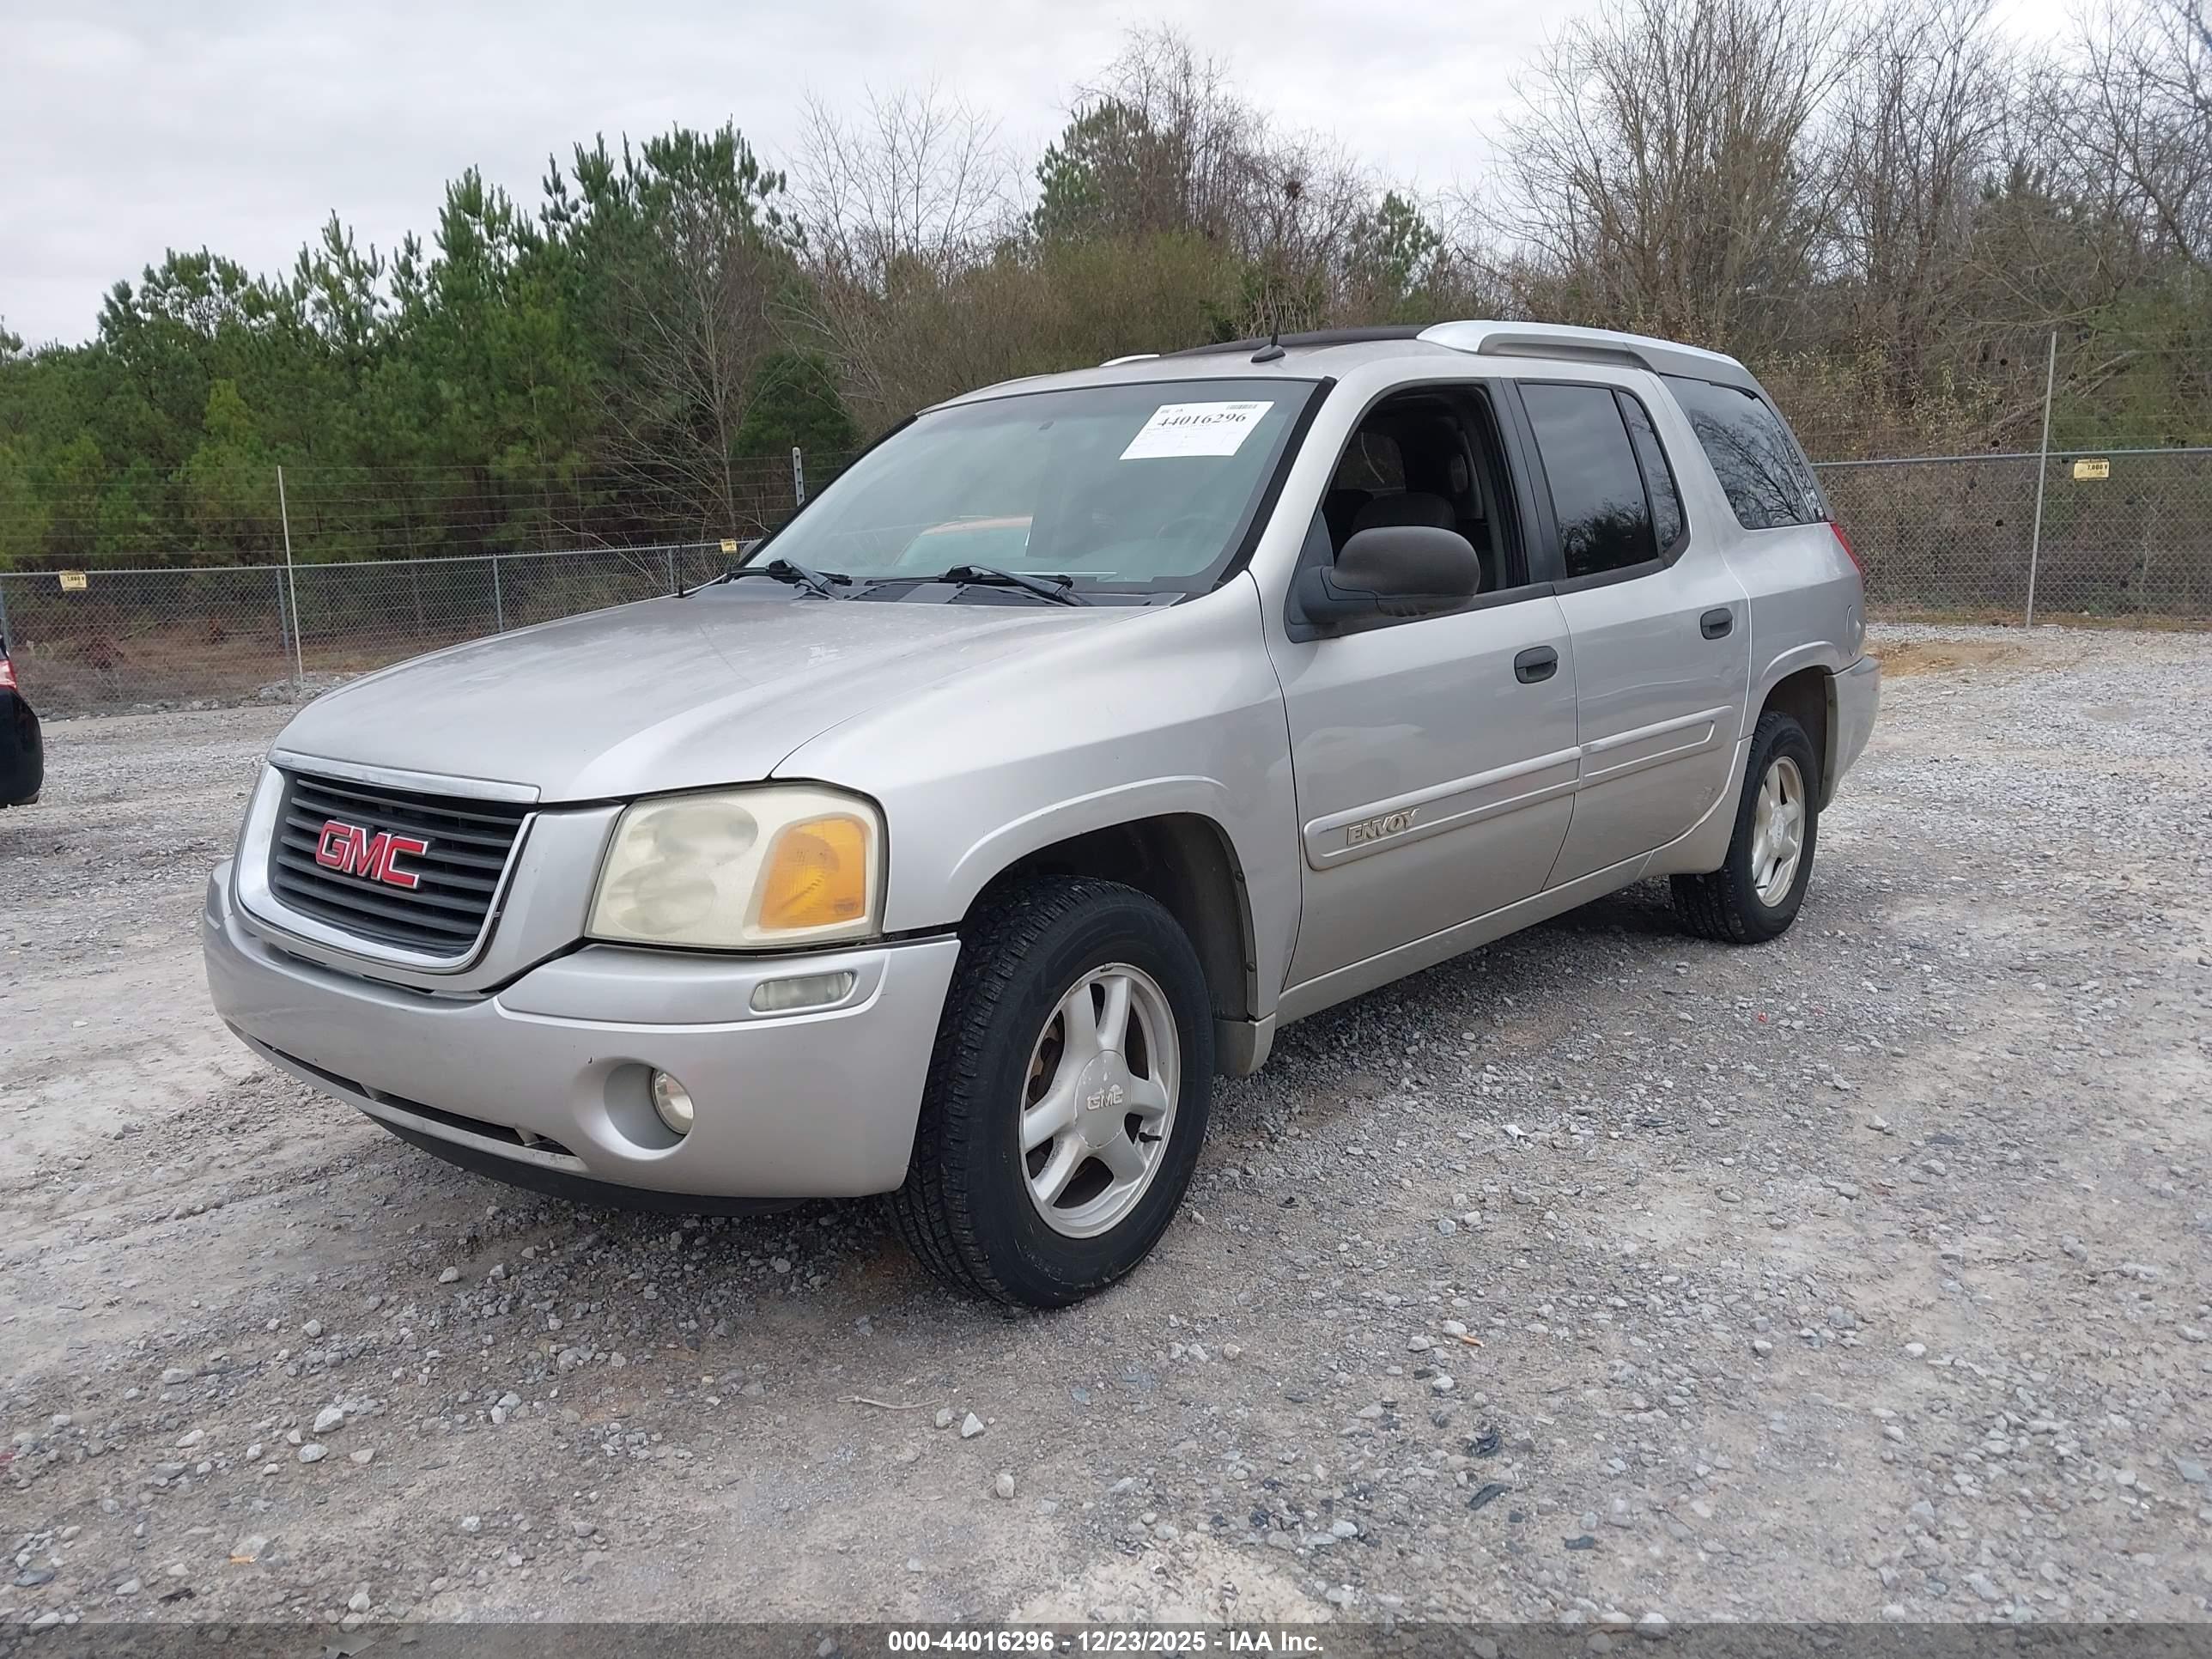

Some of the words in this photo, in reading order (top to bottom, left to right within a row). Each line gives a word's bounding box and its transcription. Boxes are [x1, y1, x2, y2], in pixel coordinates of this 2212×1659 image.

[1157, 412, 1248, 427] 44016296
[1346, 807, 1421, 846] ENVOY
[315, 819, 429, 890] GMC
